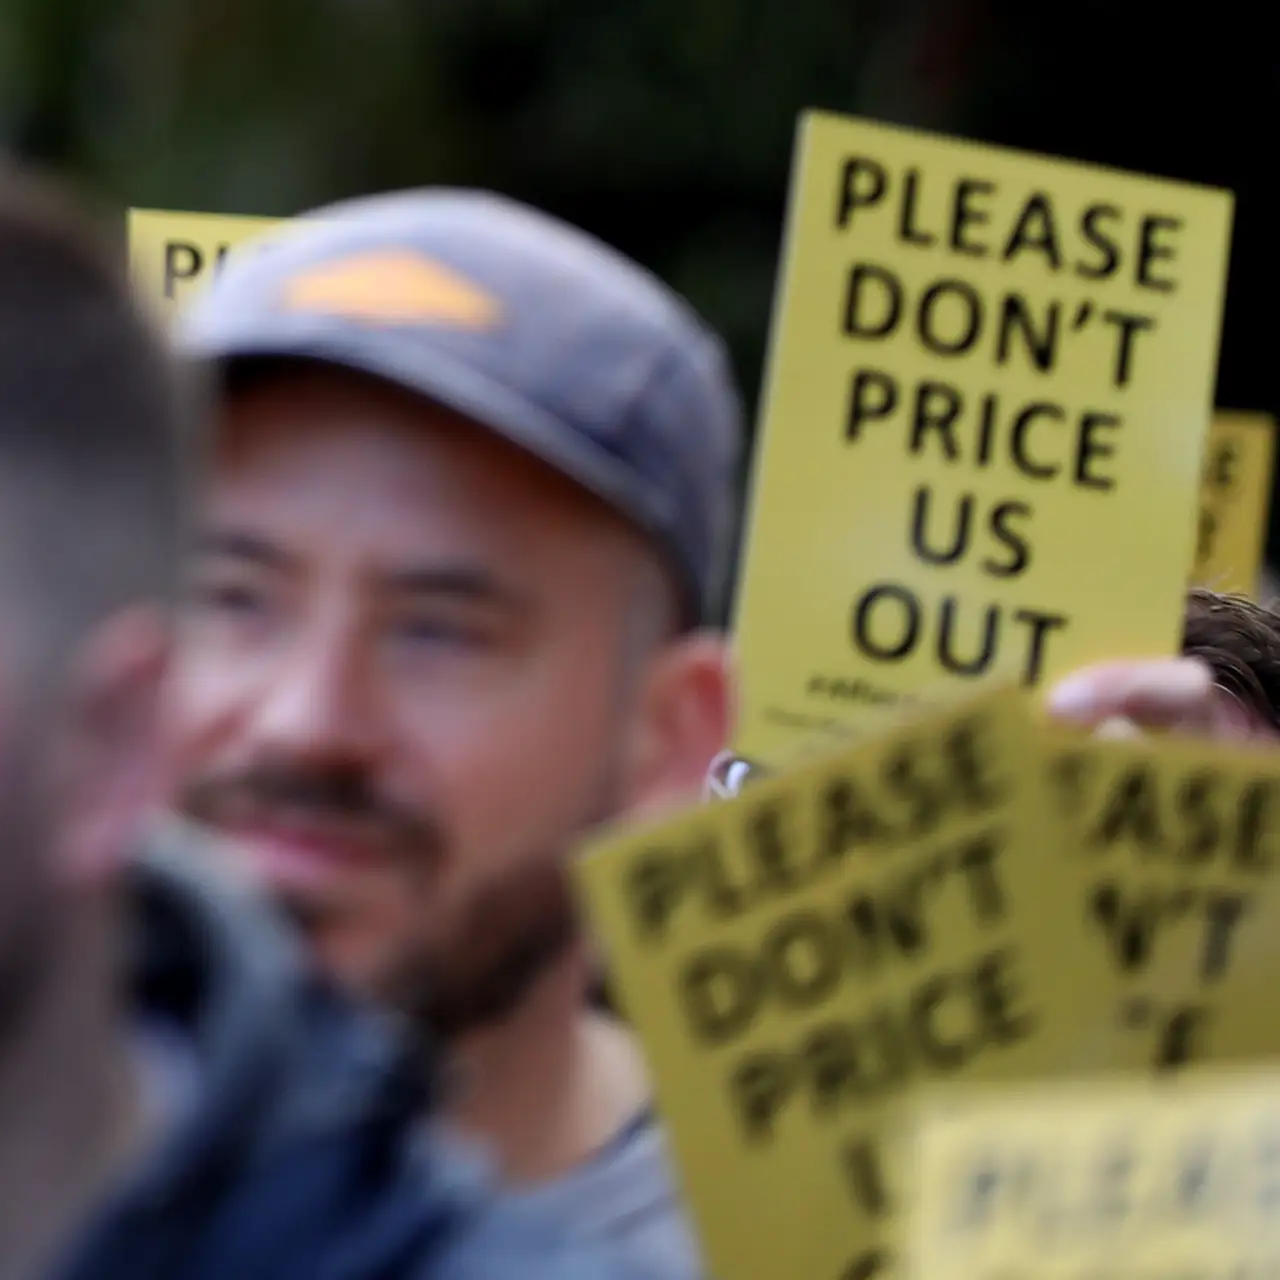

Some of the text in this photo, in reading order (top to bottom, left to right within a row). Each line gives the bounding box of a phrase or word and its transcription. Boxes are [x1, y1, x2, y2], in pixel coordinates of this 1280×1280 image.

[834, 155, 1185, 293] PLEASE
[842, 262, 1158, 391] DON'T
[844, 368, 1123, 491] PRICE
[909, 485, 1033, 580] US
[852, 582, 1069, 690] OUT
[626, 721, 1006, 942] PLEASE
[730, 946, 1035, 1150] PRICE
